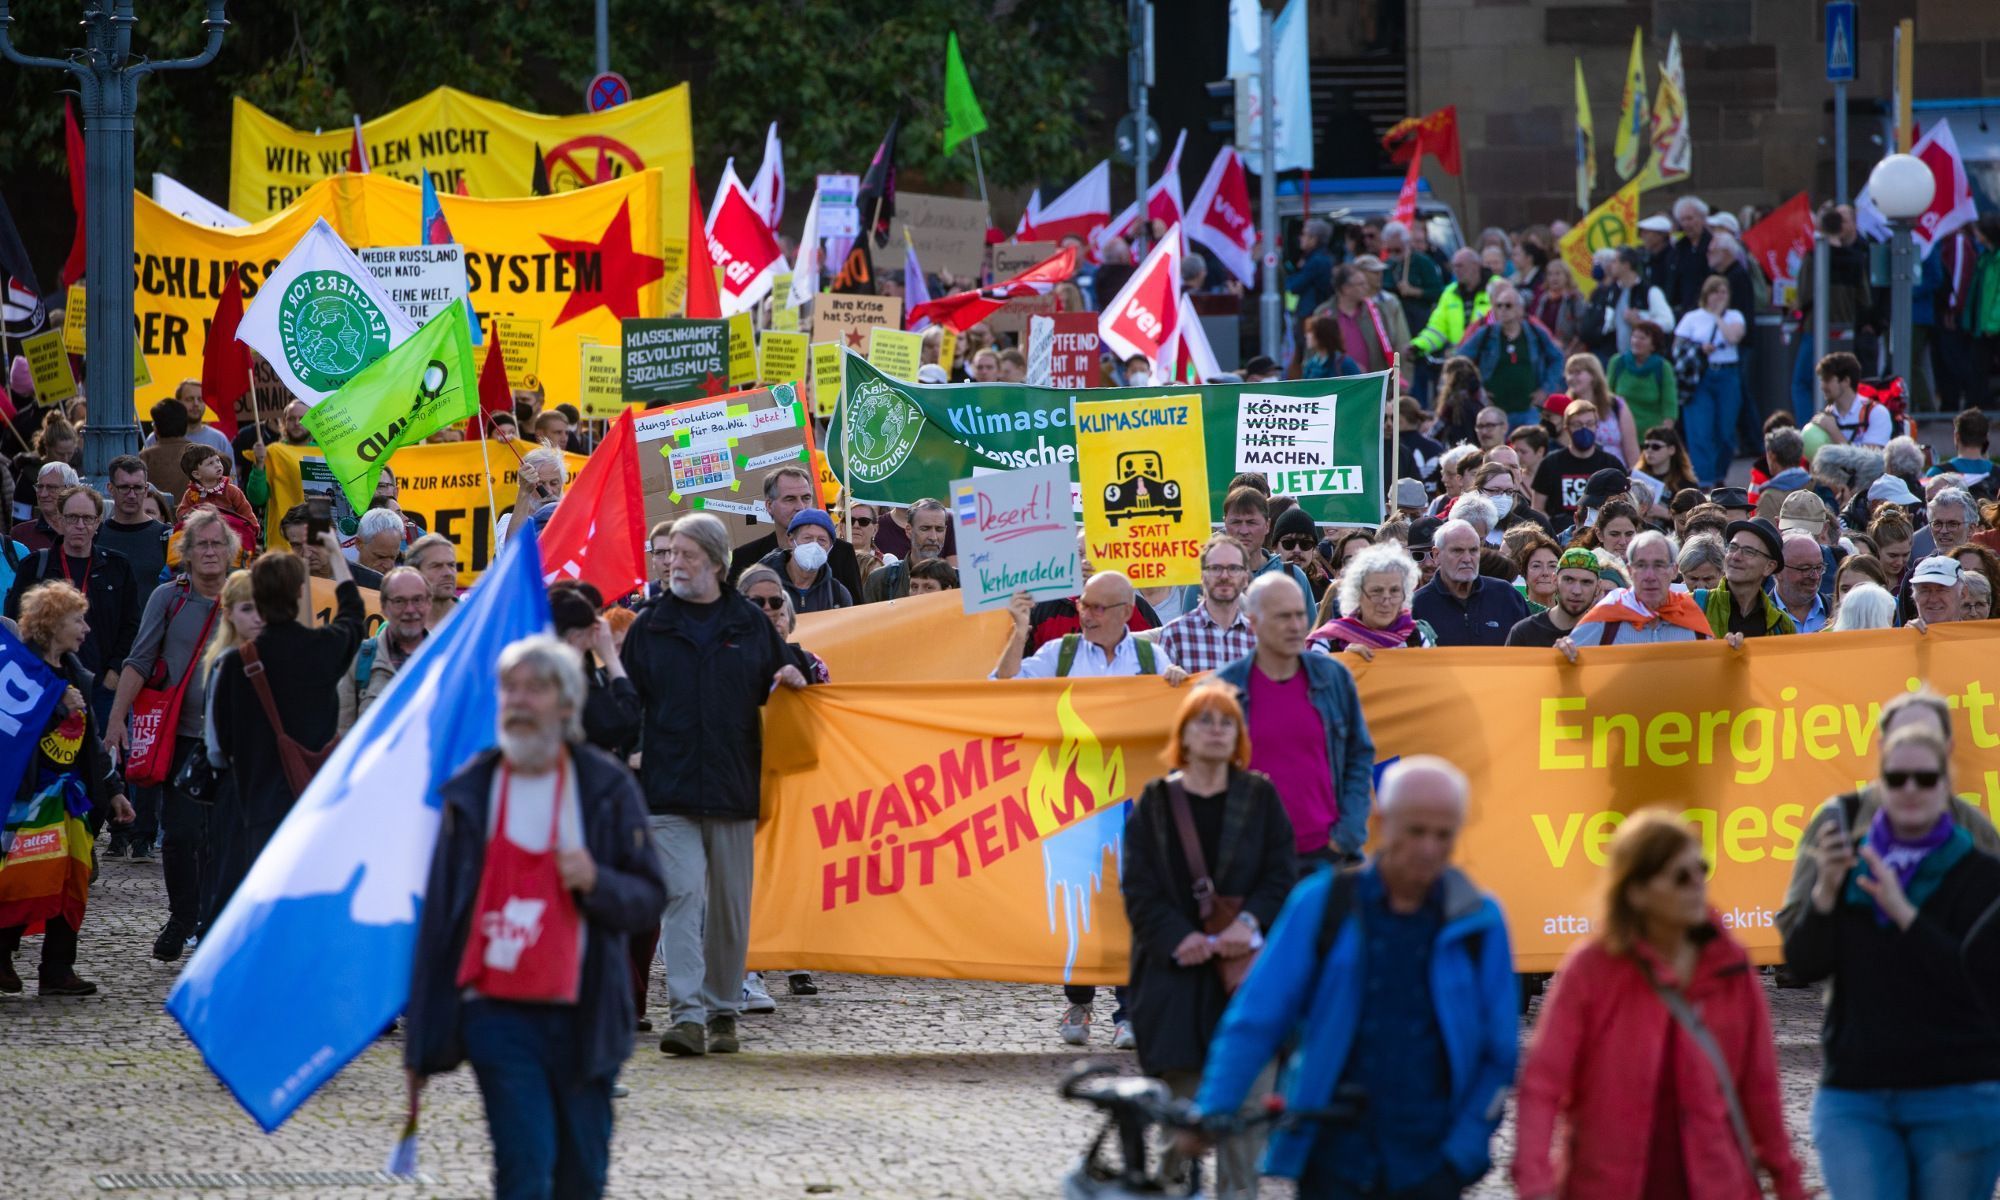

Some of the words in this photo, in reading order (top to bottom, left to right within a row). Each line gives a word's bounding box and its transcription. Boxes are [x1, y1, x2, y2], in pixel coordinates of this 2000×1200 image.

[266, 146, 312, 172] WIR
[318, 137, 411, 174] WOLEN
[419, 128, 489, 159] NICHT
[362, 251, 395, 263] WEDER
[399, 249, 458, 263] RUSSLAND
[368, 265, 391, 278] OCH
[395, 265, 426, 277] NATO-
[465, 251, 602, 294] SYSTEM
[392, 288, 417, 301] EINE
[421, 288, 453, 302] WELT,
[410, 304, 429, 318] DIE
[832, 299, 854, 311] Ihre
[856, 300, 883, 312] Krise
[823, 312, 841, 322] hat
[844, 312, 888, 324] System.
[627, 325, 723, 348] KLASSENKAMPF.
[1051, 333, 1099, 351] PTFEIND
[590, 355, 602, 363] WIR
[1075, 354, 1088, 371] IM
[589, 366, 617, 374] FRIEREN
[589, 376, 610, 385] NICHT
[1051, 375, 1086, 388] ENEN
[847, 382, 895, 443] SCHWÄBIS
[1247, 399, 1319, 415] KÖNNTE
[635, 409, 724, 433] ldungsEvolution
[1079, 406, 1189, 433] KLIMASCHUTZ
[1246, 415, 1309, 431] WÜRDE
[690, 426, 707, 438] für
[1245, 430, 1296, 447] HÄTTE
[849, 453, 868, 477] FOR
[870, 438, 910, 478] FUTURE
[1244, 451, 1326, 466] MACHEN.
[413, 476, 437, 489] ZUR
[442, 473, 481, 488] KASSE
[1271, 468, 1358, 495] JETZT.
[1562, 478, 1588, 495] FC
[978, 480, 1051, 532] Desert!
[1128, 524, 1170, 538] STATT
[980, 553, 1074, 594] Verhandeln!
[1127, 563, 1166, 579] GIER
[42, 737, 63, 761] EIN
[812, 733, 1024, 850] WARME
[23, 834, 56, 848] attac
[822, 787, 1039, 912] HÜTTEN
